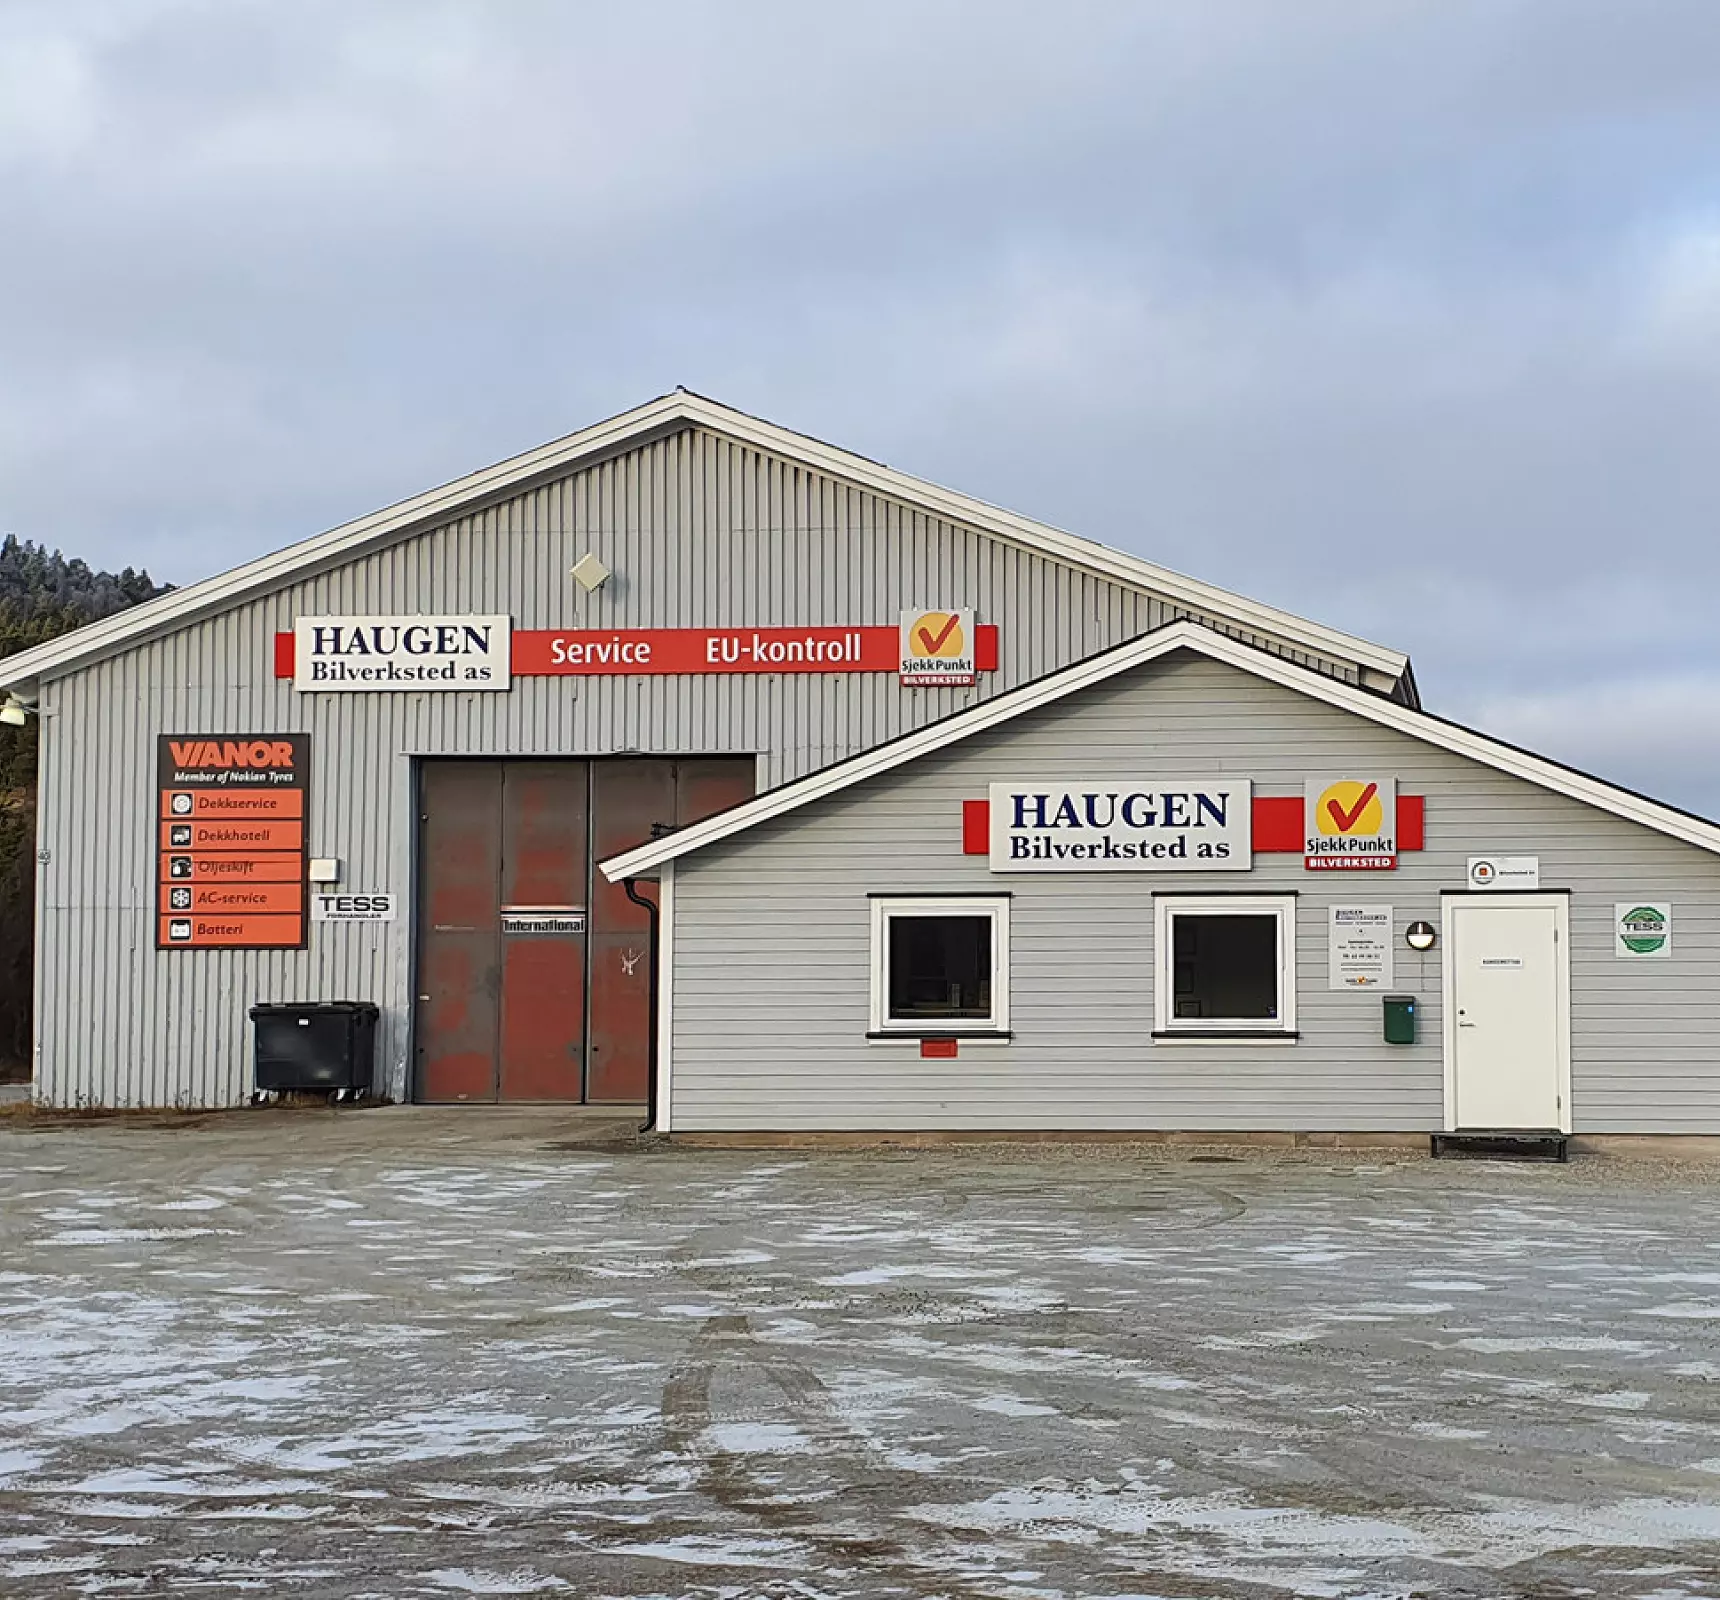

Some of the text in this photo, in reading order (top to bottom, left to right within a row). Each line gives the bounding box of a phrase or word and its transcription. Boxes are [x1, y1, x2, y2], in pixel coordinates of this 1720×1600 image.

[311, 626, 493, 656] HAUGEN
[550, 637, 651, 665] Service
[706, 633, 862, 663] EU-kontroll
[311, 660, 493, 682] Bilverksted as
[903, 676, 972, 685] BILVERKSTED
[169, 740, 294, 768] VIANOR
[174, 770, 293, 784] Member of Nokian Tyres
[198, 797, 277, 809] Dekkservice
[1010, 793, 1230, 829] HAUGEN
[197, 829, 270, 841] Dekkhotell
[1010, 836, 1230, 860] Bilverksted as
[199, 861, 254, 874] Oljeskift
[1309, 858, 1391, 868] BILVERKSTED
[197, 892, 267, 904] AC-service
[318, 896, 390, 912] TESS
[197, 923, 243, 936] Batteri
[504, 919, 584, 932] International
[1625, 922, 1662, 931] TESS
